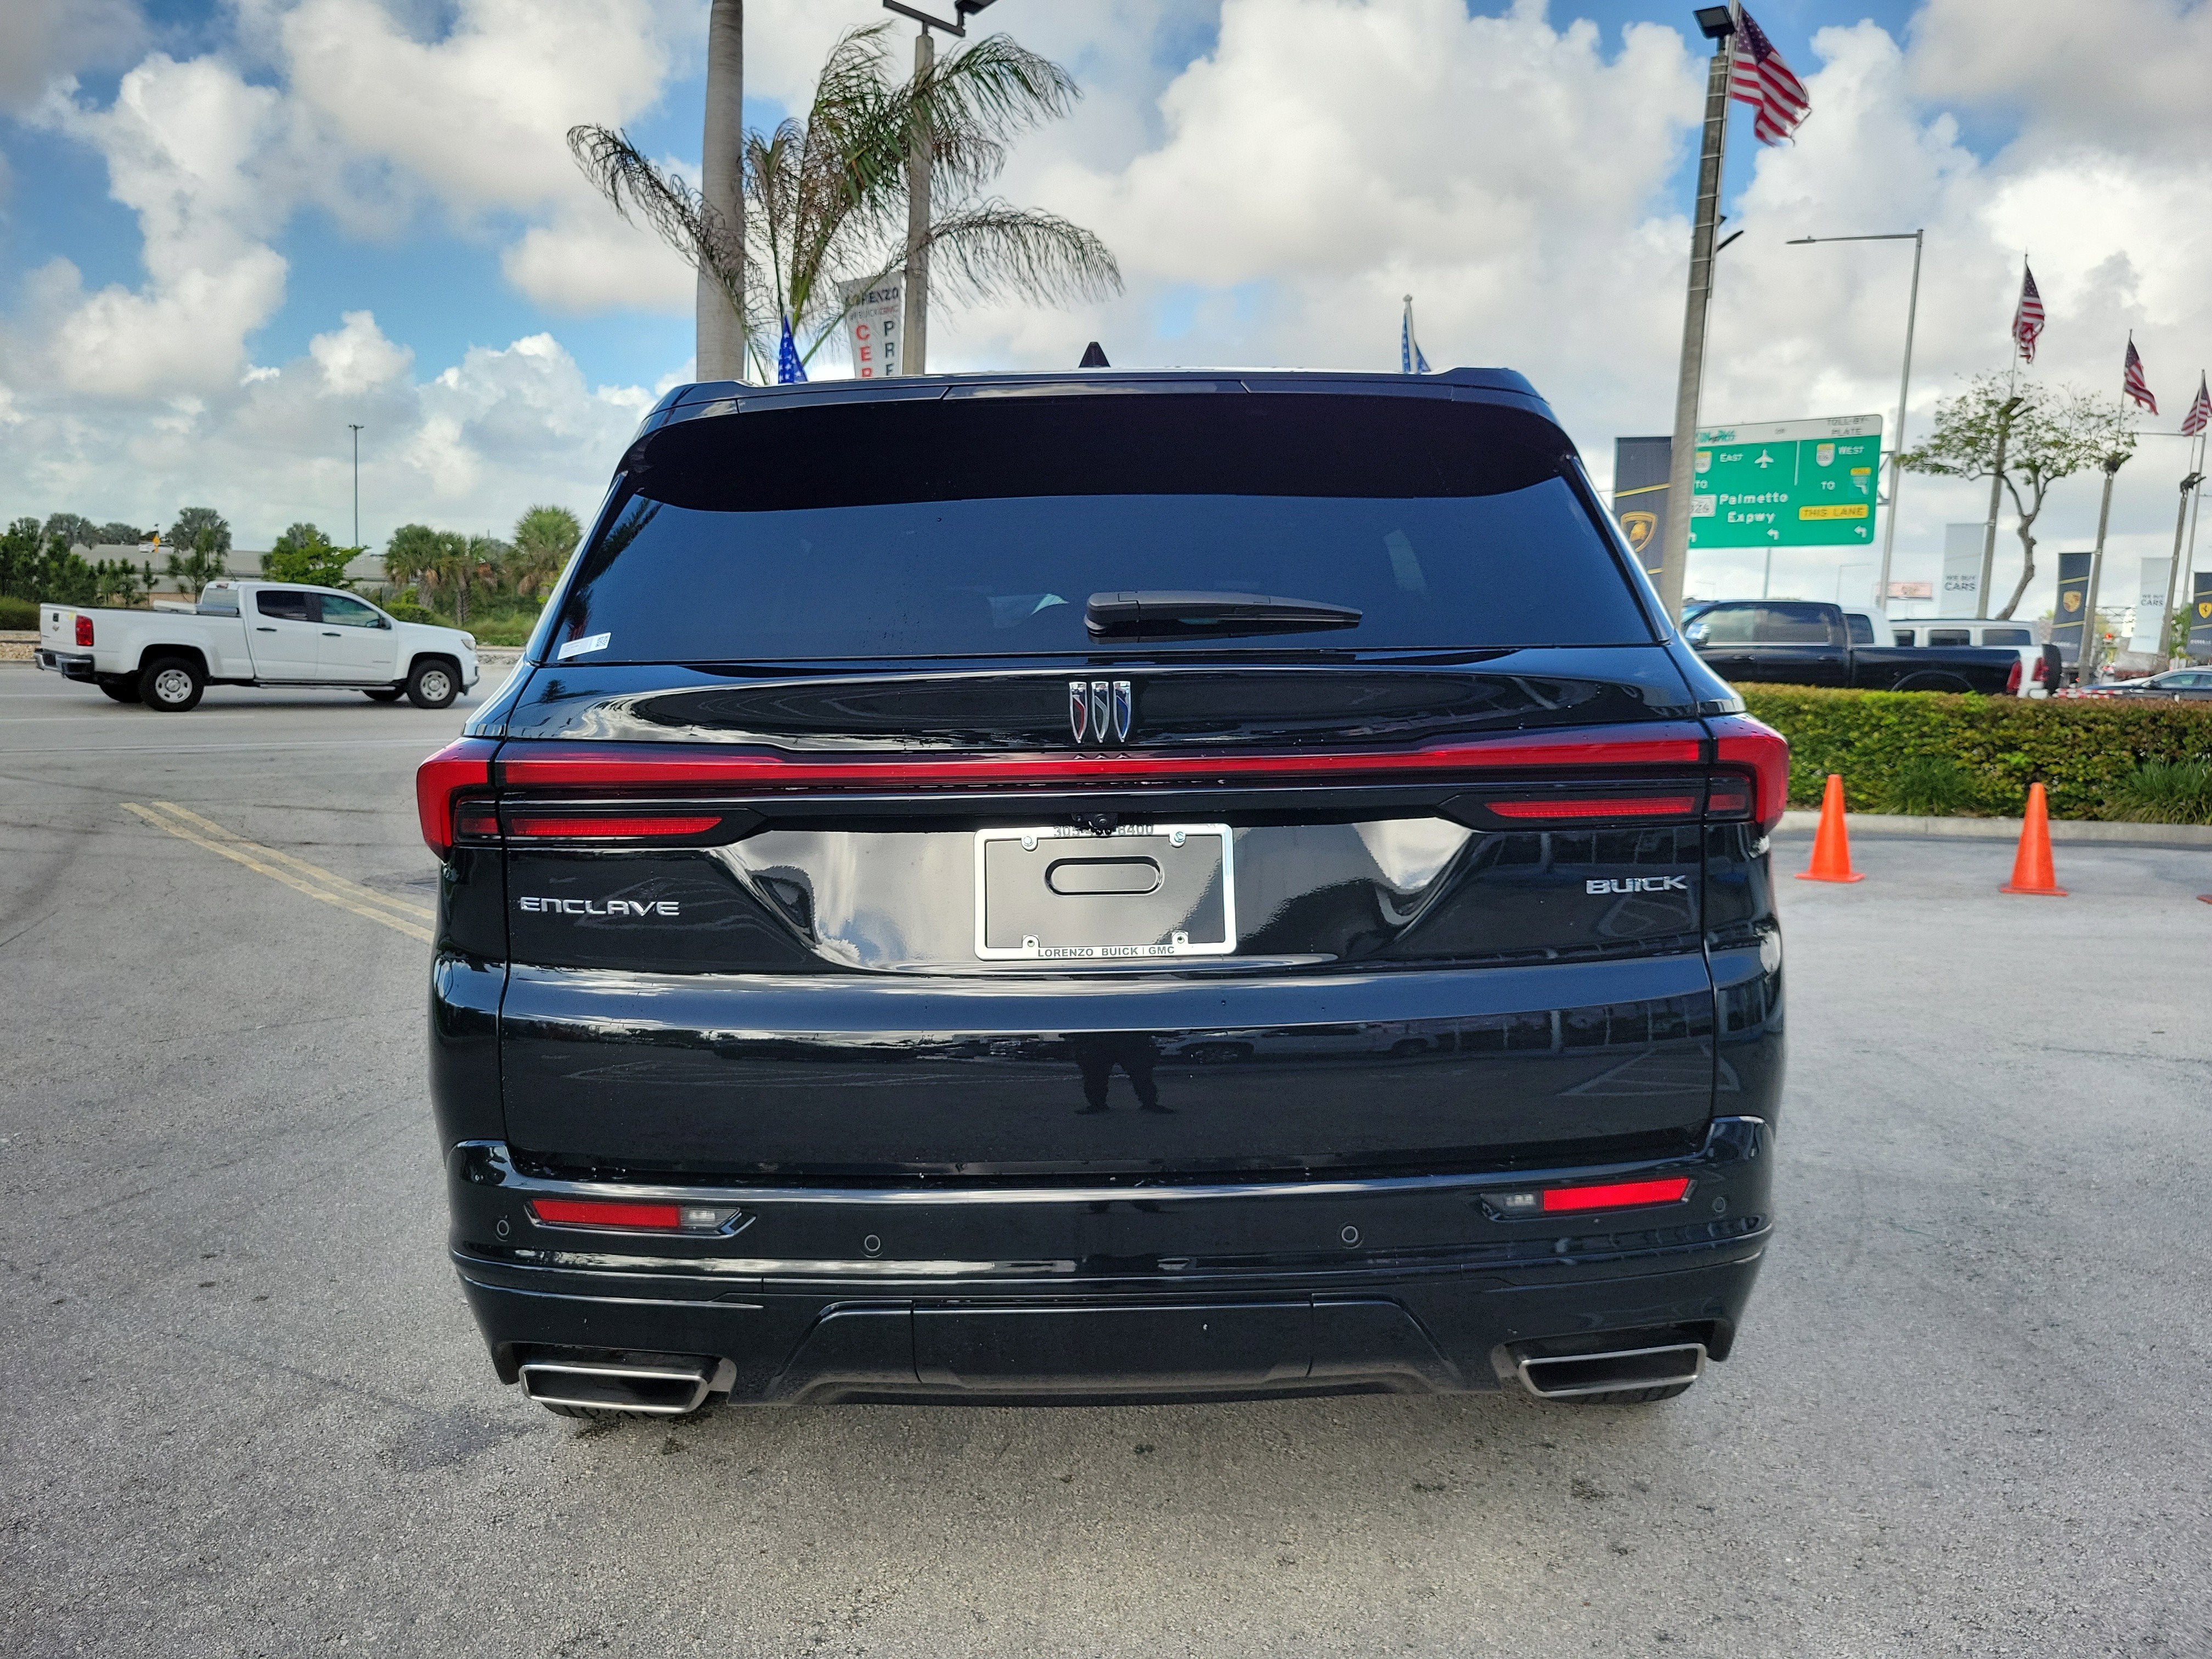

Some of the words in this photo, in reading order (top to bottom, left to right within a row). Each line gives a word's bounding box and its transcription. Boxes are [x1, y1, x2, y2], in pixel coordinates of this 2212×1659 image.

[1838, 445, 1865, 455] WEST
[1719, 453, 1743, 462] EAST
[1695, 479, 1708, 489] TO
[1820, 481, 1836, 490] TO
[1719, 492, 1789, 505] Palmetto
[1803, 509, 1827, 517] THIS
[1832, 506, 1864, 517] LANE
[1727, 511, 1776, 524] Expwy
[1944, 582, 1976, 592] CARS
[1586, 874, 1688, 894] BUICK
[520, 896, 680, 916] ENCLAVE
[1037, 948, 1094, 957] LORENZO
[1102, 947, 1138, 956] BUICK
[1148, 946, 1175, 955] GMC
